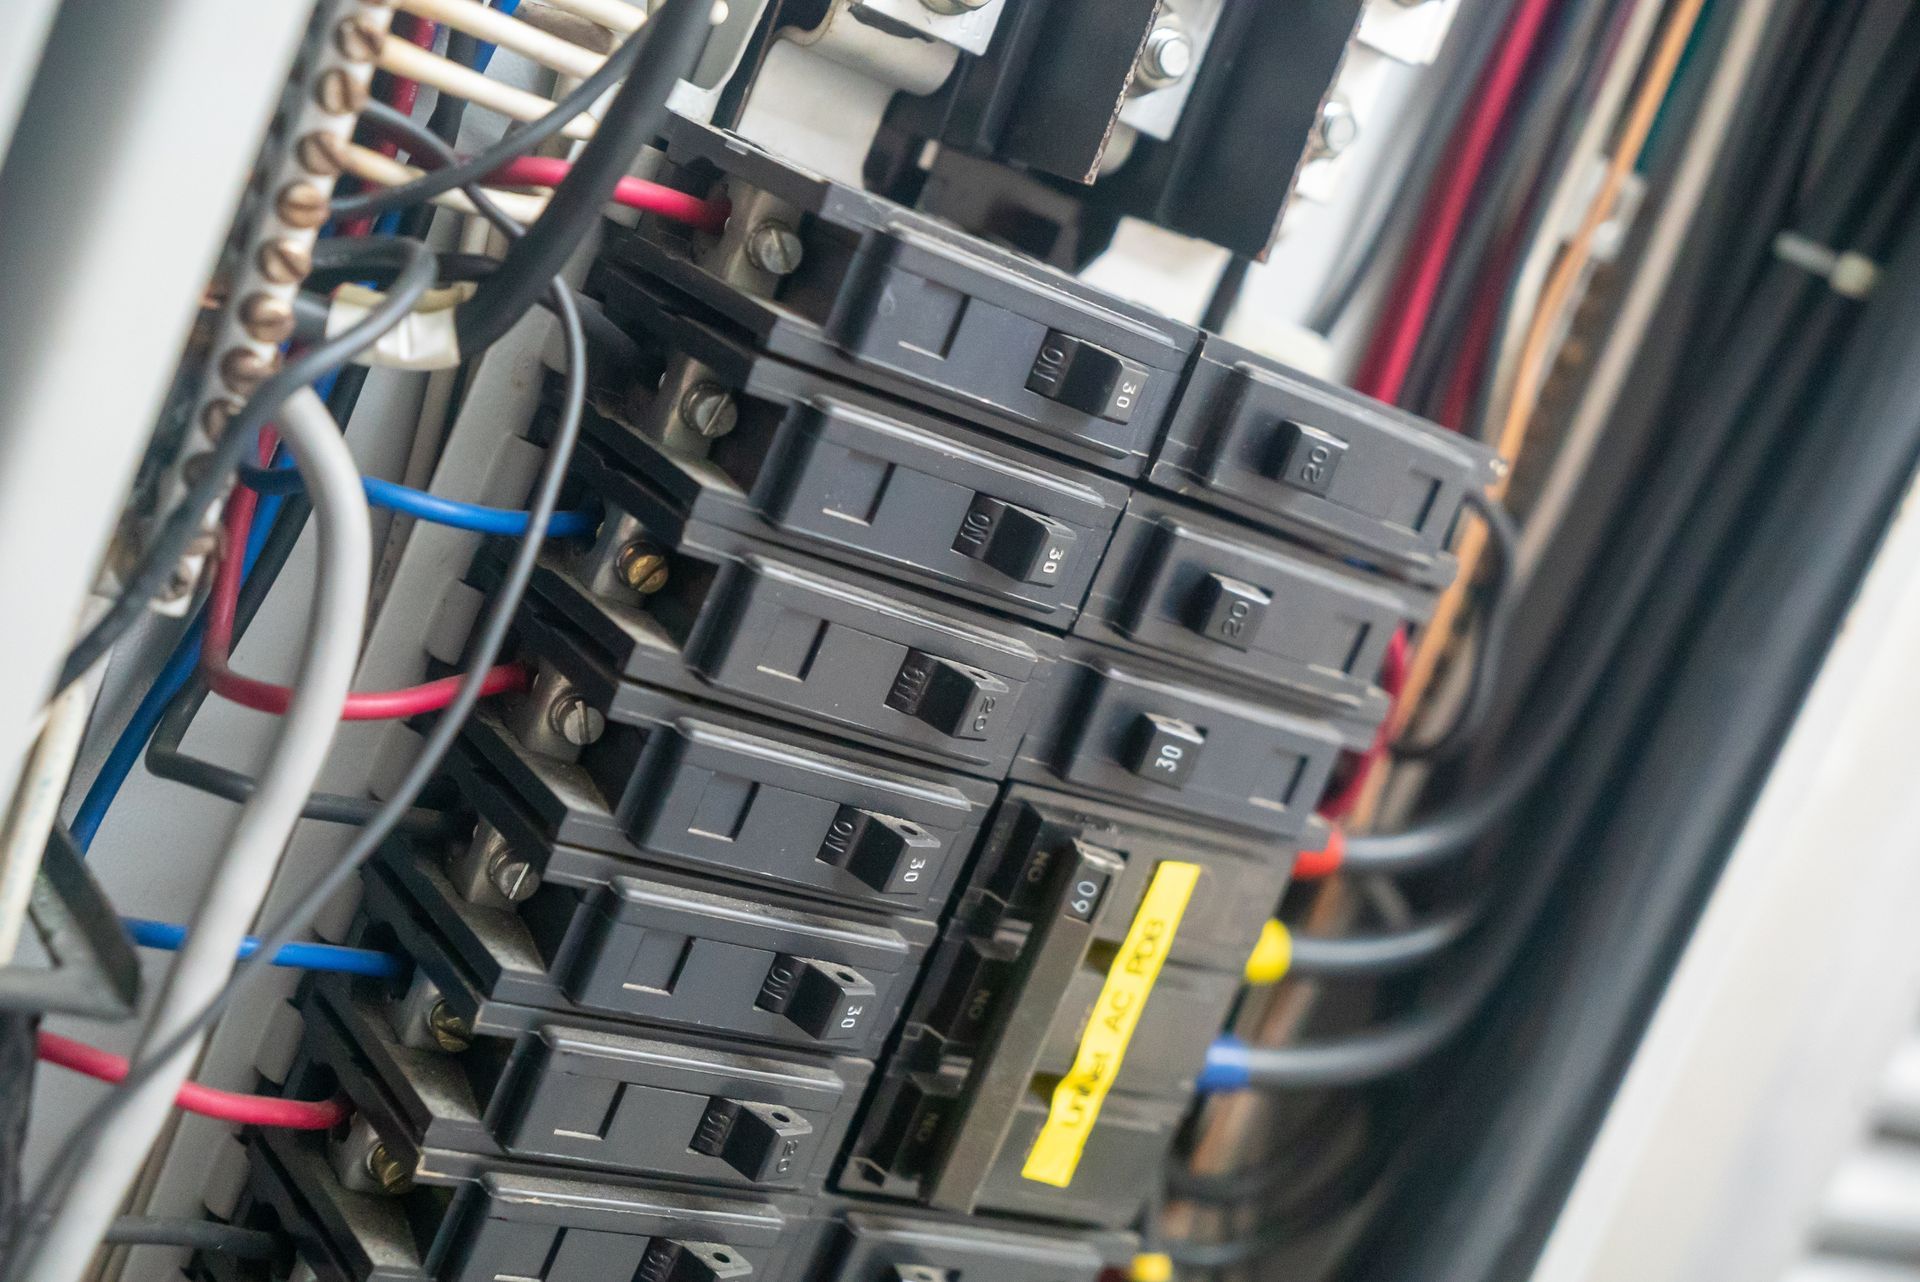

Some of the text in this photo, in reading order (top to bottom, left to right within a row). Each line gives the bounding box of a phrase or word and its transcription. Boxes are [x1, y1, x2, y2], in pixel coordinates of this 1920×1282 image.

[1033, 346, 1064, 383] ON
[1116, 381, 1138, 409] 30
[1301, 445, 1330, 484] 20
[960, 511, 991, 545] ON
[1043, 547, 1063, 573] 30
[1221, 600, 1250, 638] 20
[973, 696, 996, 732] 20
[1155, 744, 1183, 773] 30
[825, 820, 853, 853] ON
[903, 858, 926, 882] 30
[1071, 880, 1098, 914] 60
[762, 965, 793, 1000] ON
[840, 1005, 863, 1028] 30
[1103, 990, 1136, 1033] AC
[776, 1139, 799, 1174] 20
